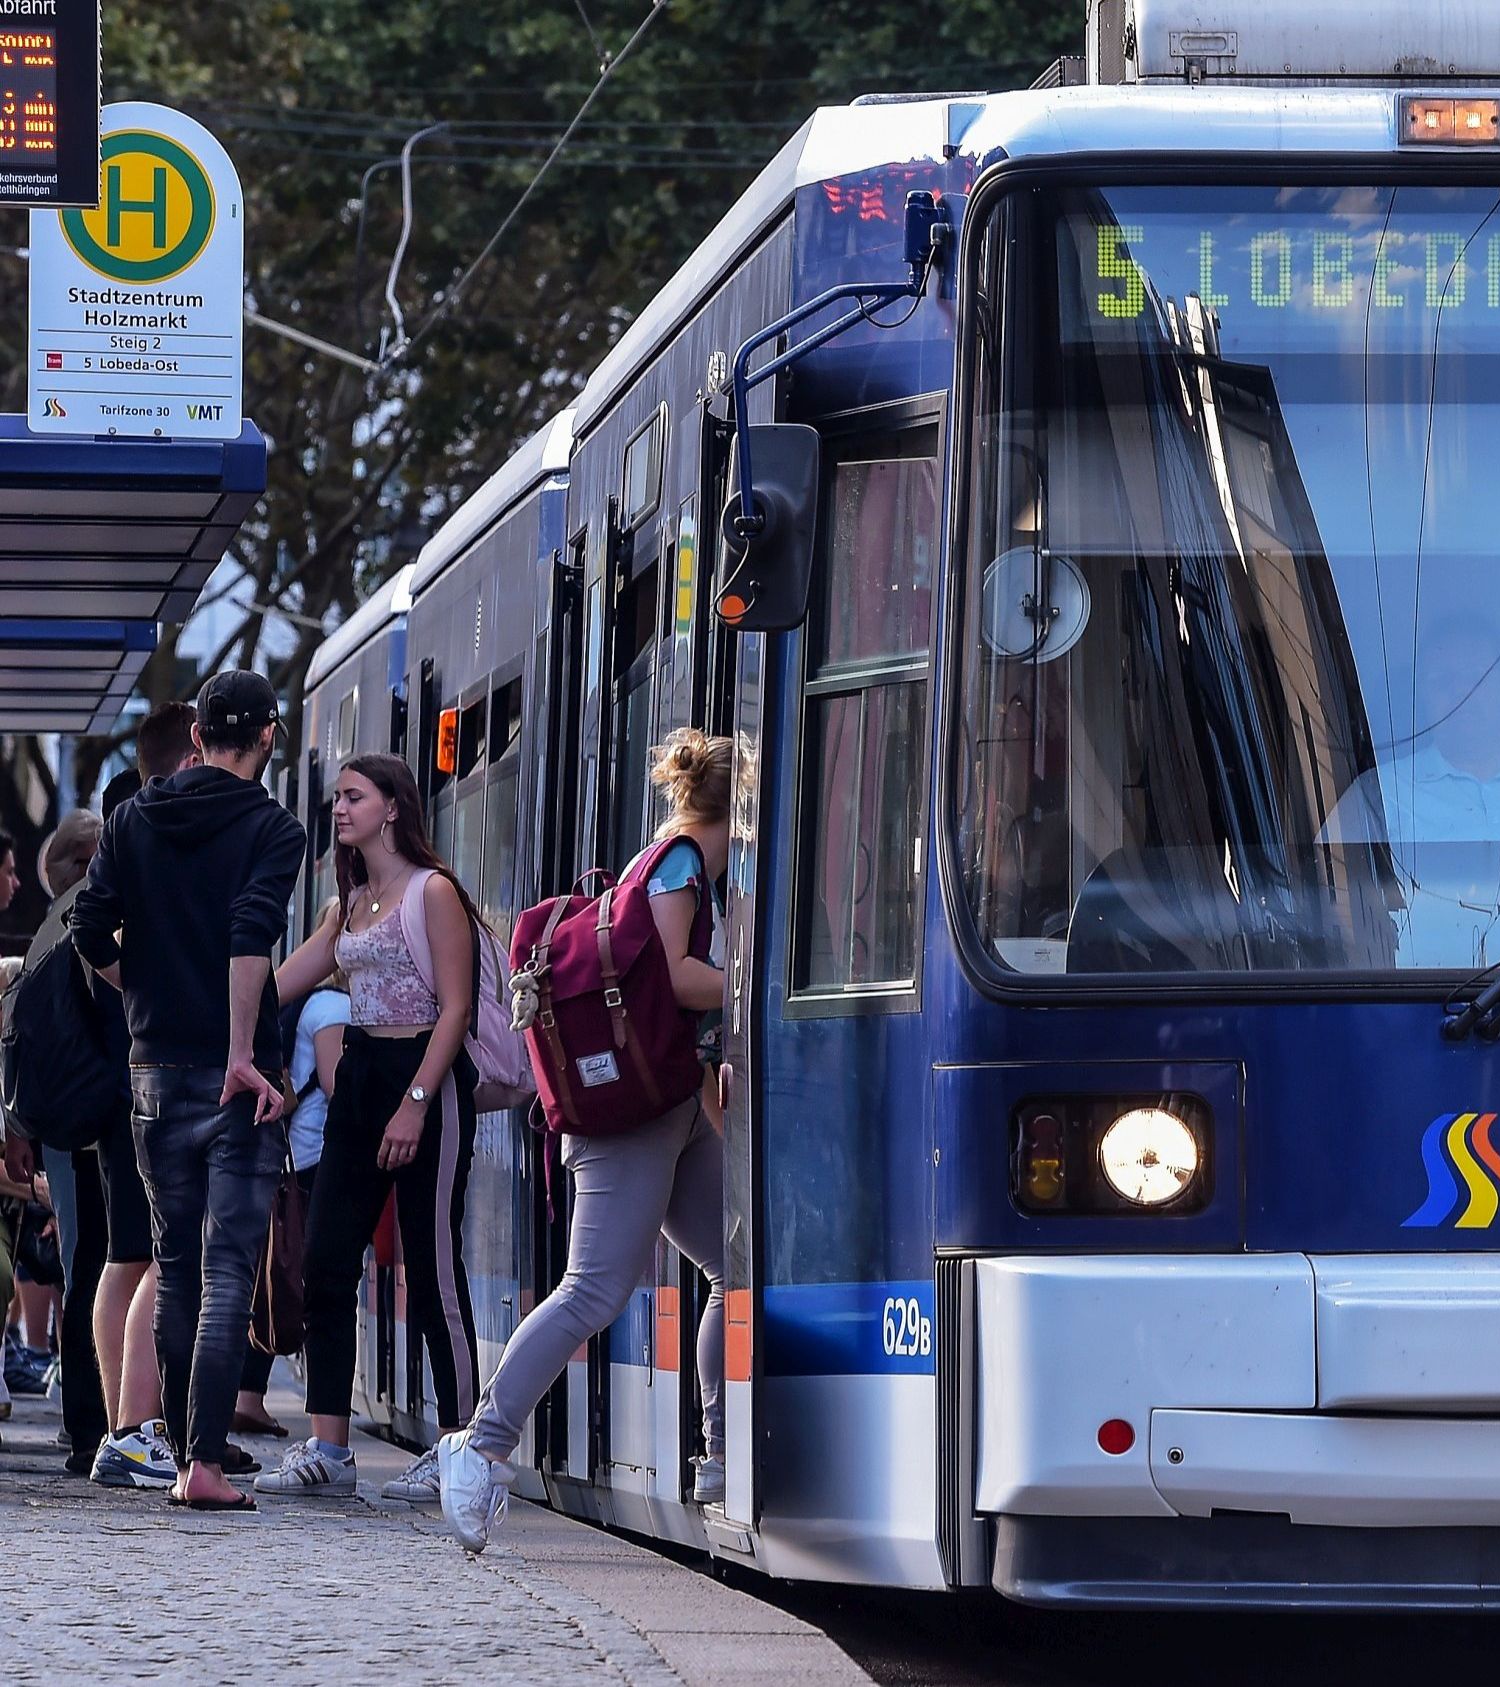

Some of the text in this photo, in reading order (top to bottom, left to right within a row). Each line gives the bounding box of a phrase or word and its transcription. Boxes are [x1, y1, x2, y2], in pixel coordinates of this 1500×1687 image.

[0, 0, 56, 15] bfahrt
[1098, 225, 1144, 318] 5
[68, 287, 204, 308] Stadtzentrum
[85, 310, 188, 329] Holzmarkt
[110, 335, 161, 351] Steig 2
[84, 357, 179, 372] 5 Lobeda-Ost
[99, 404, 170, 417] Tarifzone 30
[187, 404, 224, 421] VMT
